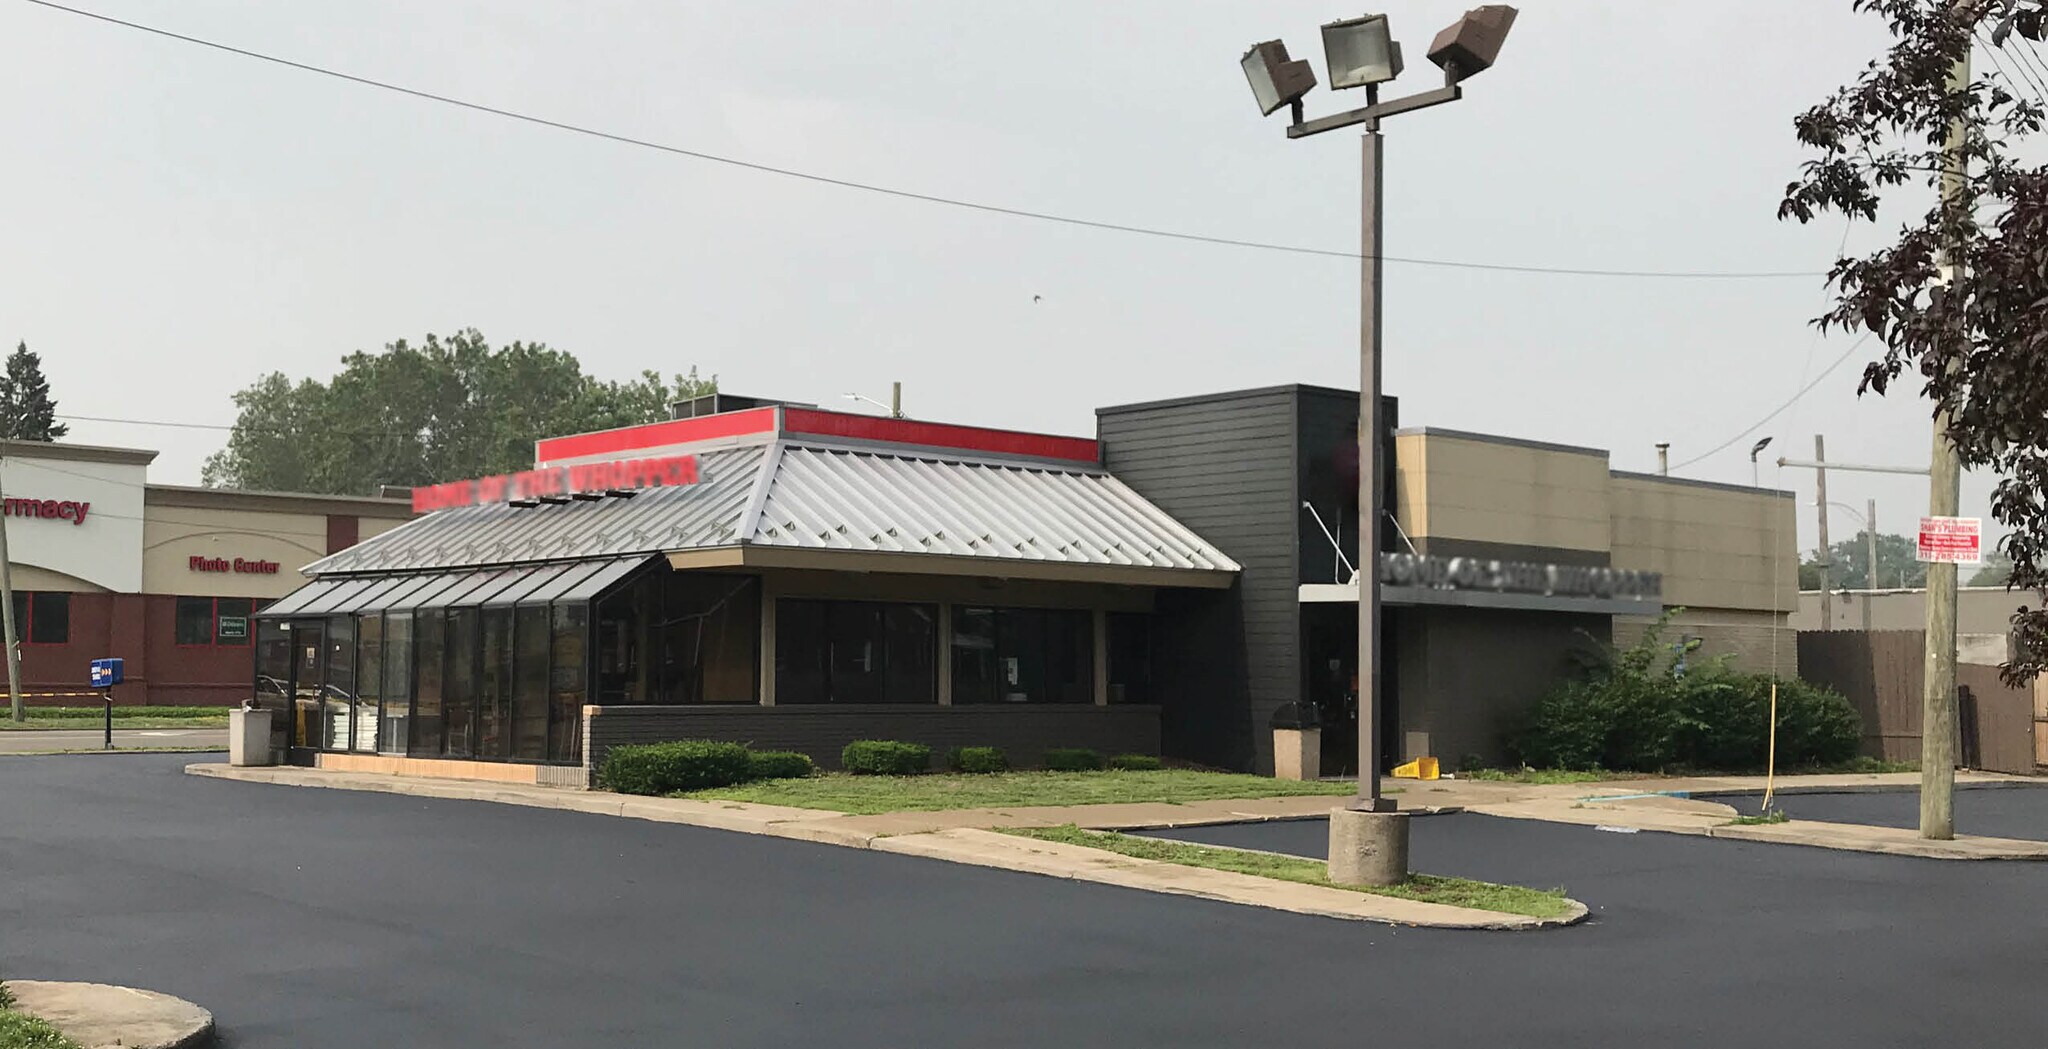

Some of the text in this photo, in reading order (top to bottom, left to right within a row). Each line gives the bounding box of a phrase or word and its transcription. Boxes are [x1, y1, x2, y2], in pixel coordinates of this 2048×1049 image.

[3, 498, 90, 525] rmacy
[1943, 525, 1978, 533] PLUMBING
[189, 556, 280, 574] Photo Center
